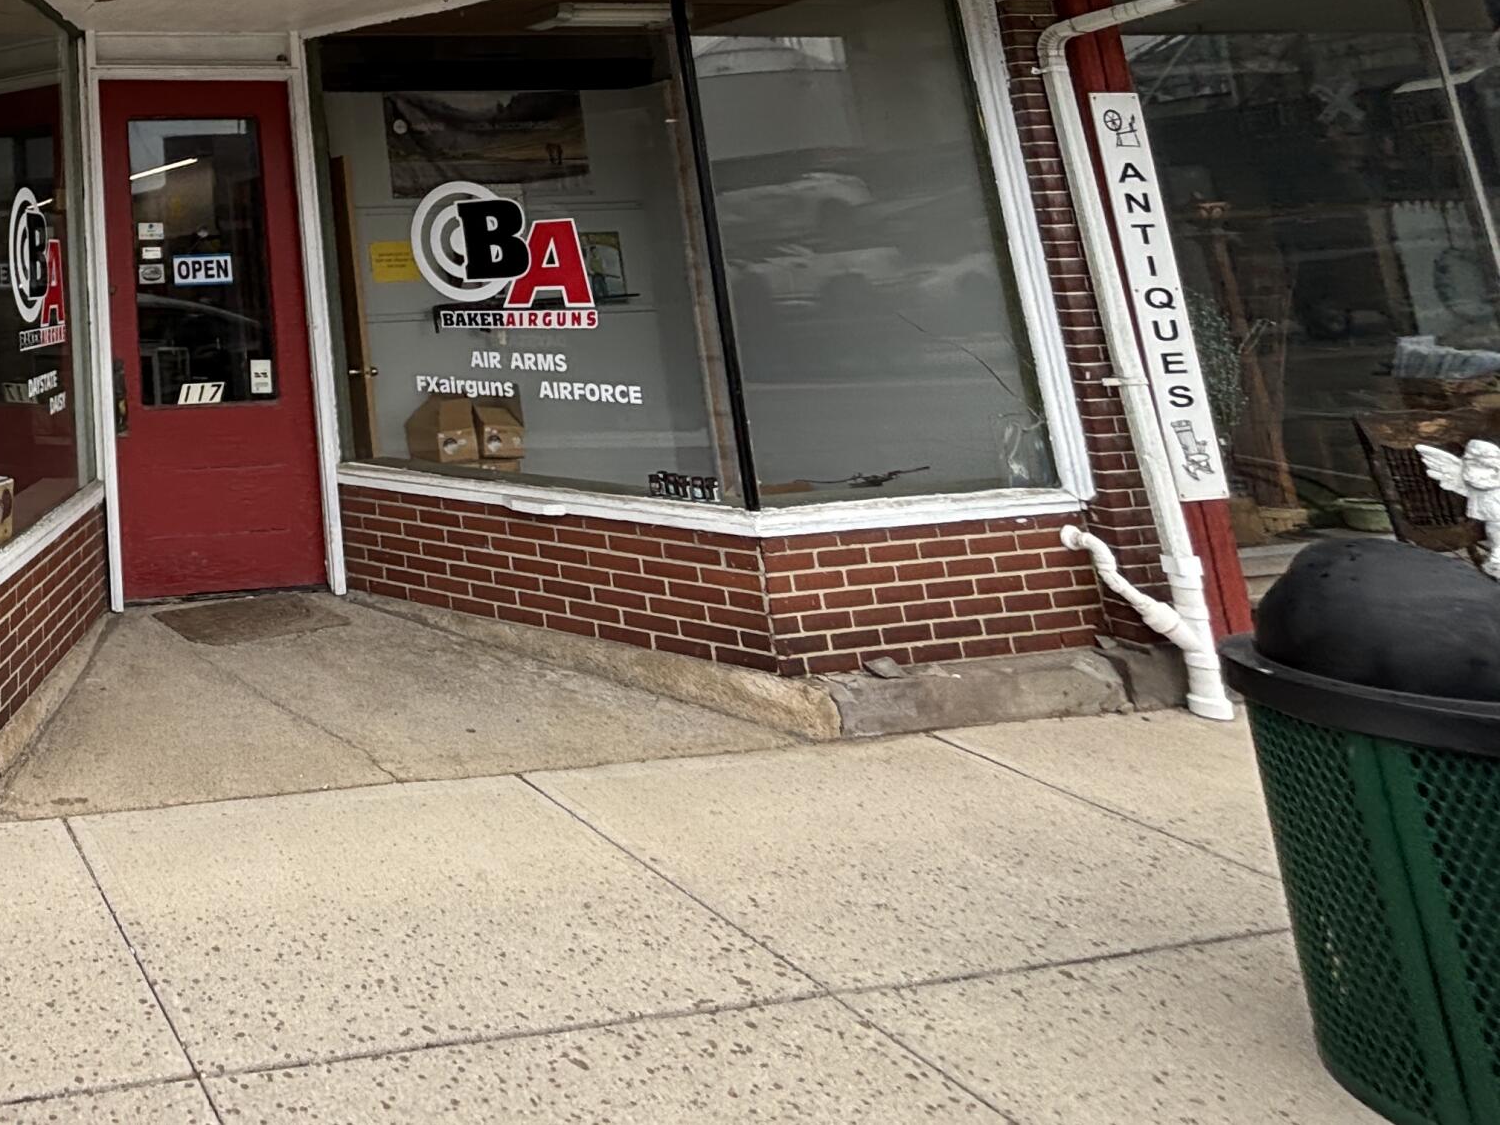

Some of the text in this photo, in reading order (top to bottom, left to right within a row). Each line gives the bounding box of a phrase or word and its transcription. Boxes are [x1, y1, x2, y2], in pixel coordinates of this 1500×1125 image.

[177, 259, 229, 280] OPEN
[1118, 161, 1195, 408] ANTIQUES
[442, 311, 597, 327] BAKERAIRGUNS
[470, 351, 568, 372] AIR ARMS
[28, 370, 58, 398] DAYSTATE
[184, 383, 222, 402] 117
[416, 376, 643, 404] FXairguns AIRFORCE
